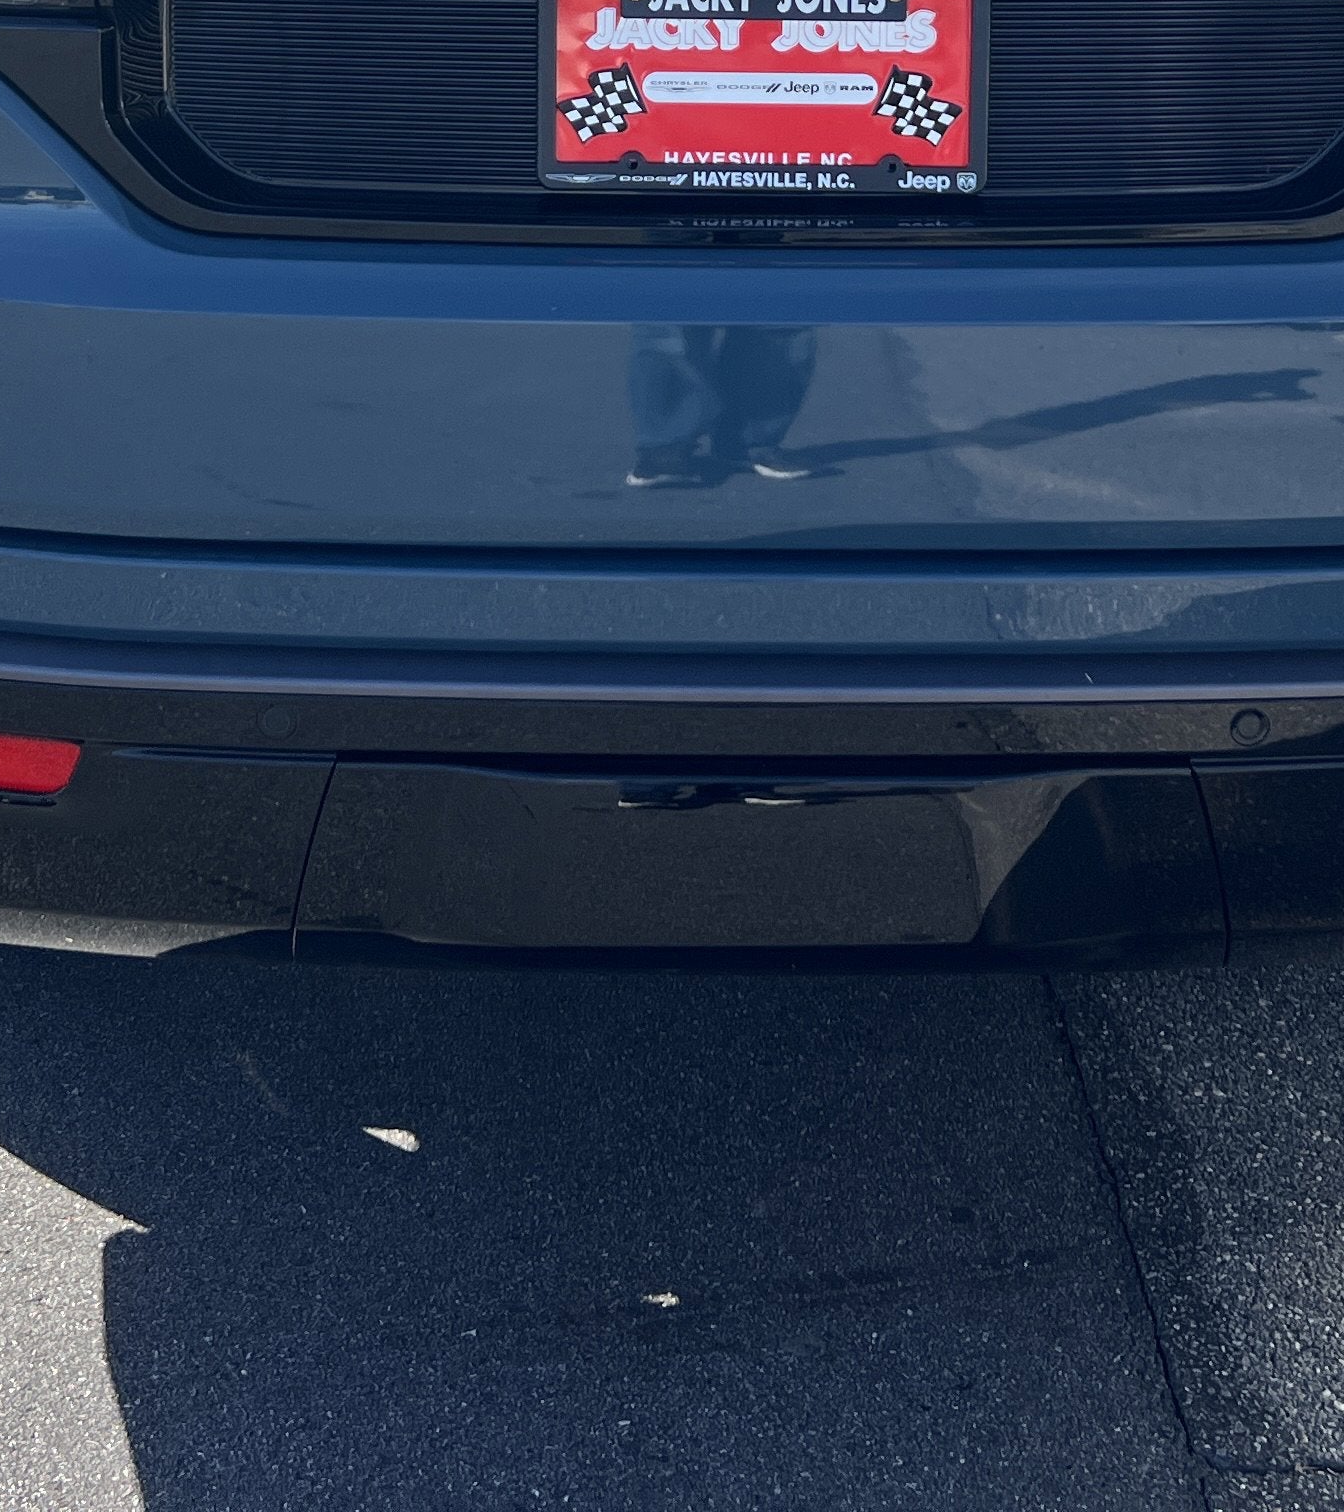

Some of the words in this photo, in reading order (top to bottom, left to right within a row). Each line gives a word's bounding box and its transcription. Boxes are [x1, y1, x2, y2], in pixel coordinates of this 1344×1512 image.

[584, 7, 746, 51] JACKY
[771, 9, 938, 53] JONES
[783, 80, 820, 95] Jeep
[692, 170, 813, 190] HAYESVILLE,
[817, 172, 856, 189] N.C.
[897, 171, 951, 192] Jeep
